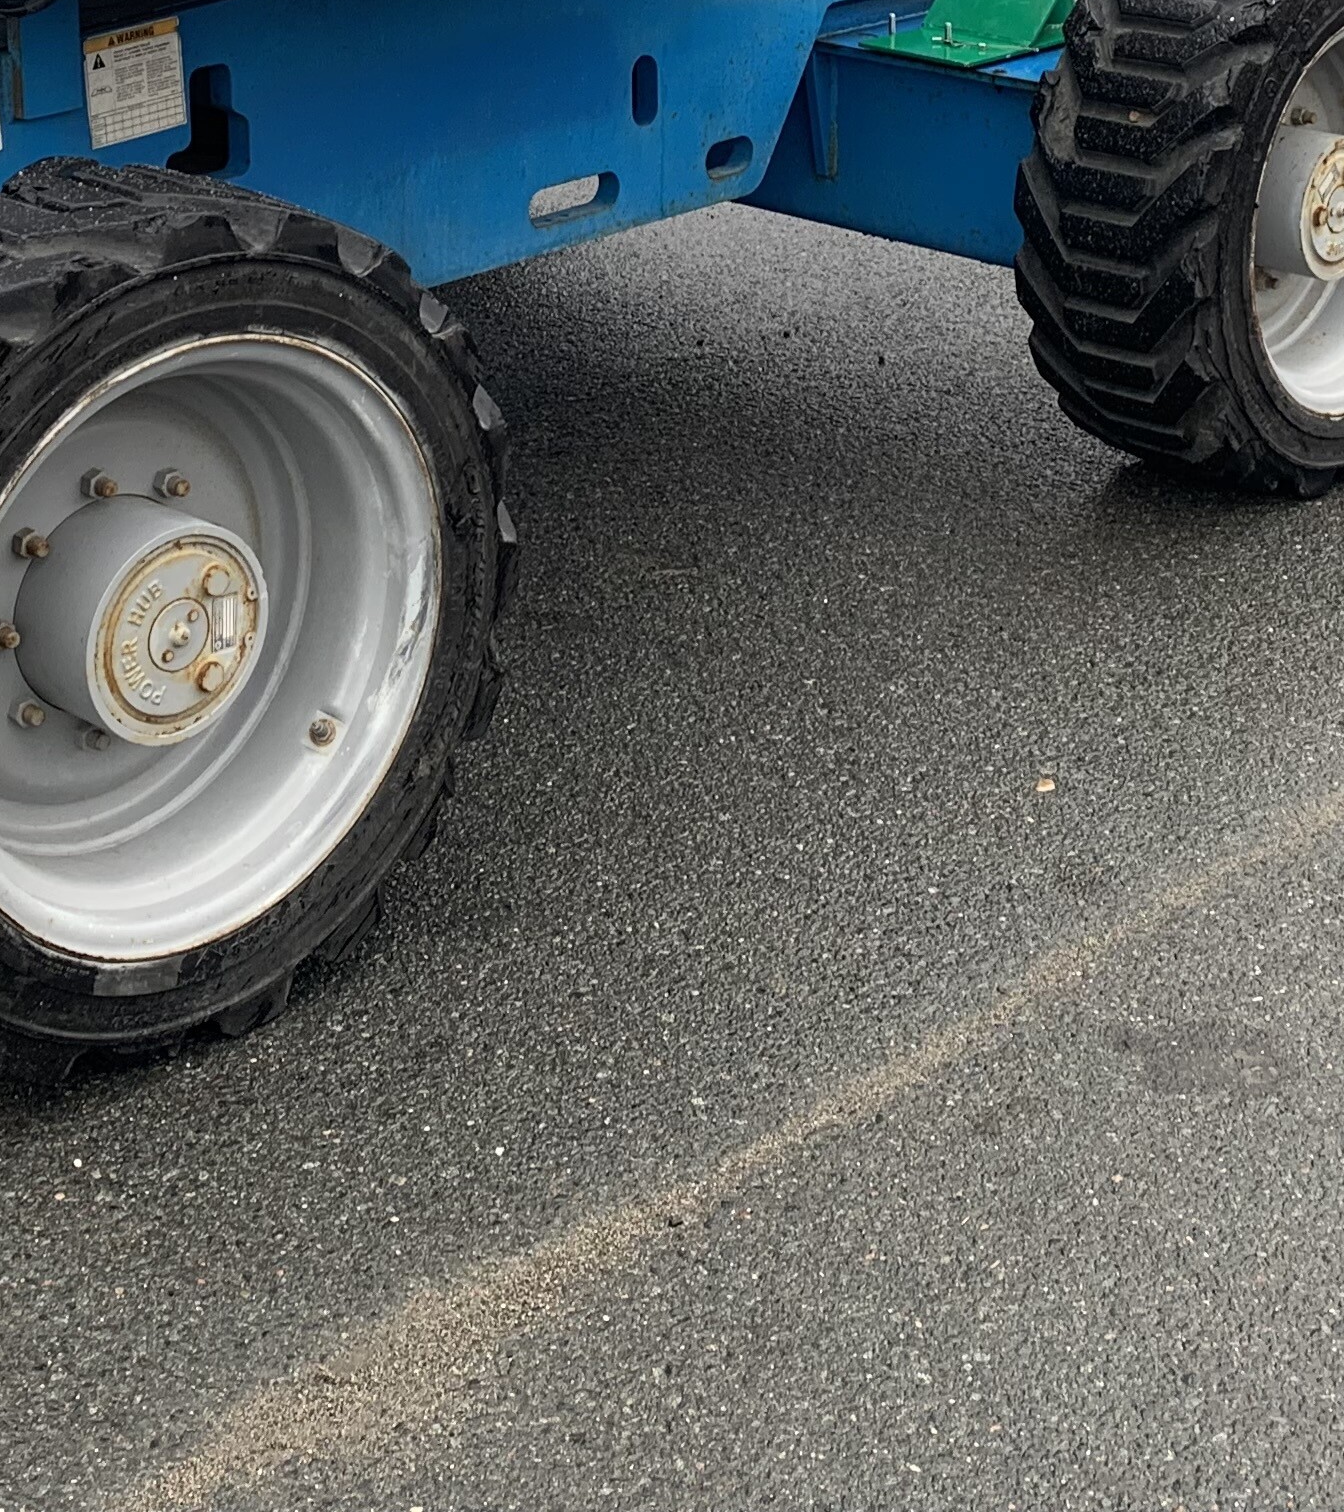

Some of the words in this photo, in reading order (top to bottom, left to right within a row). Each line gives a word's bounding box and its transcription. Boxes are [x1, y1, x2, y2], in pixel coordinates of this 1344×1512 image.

[116, 26, 155, 45] WARNING
[127, 578, 163, 627] HUB
[121, 636, 167, 706] POWER
